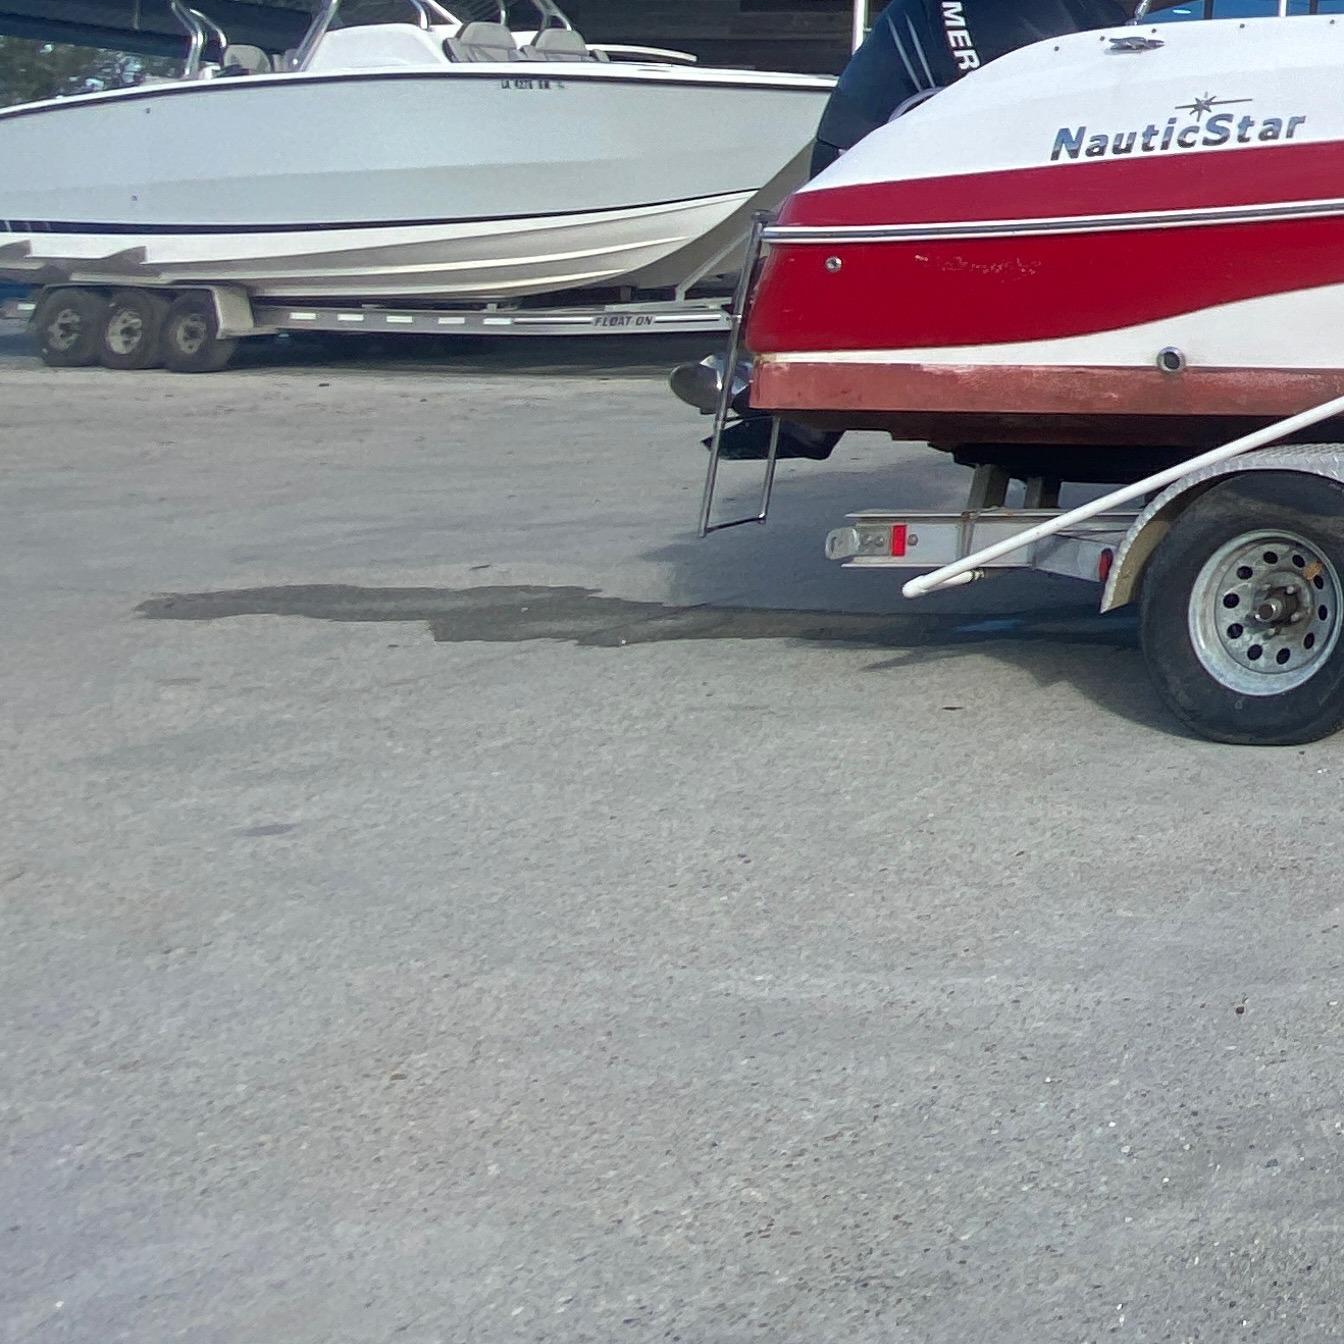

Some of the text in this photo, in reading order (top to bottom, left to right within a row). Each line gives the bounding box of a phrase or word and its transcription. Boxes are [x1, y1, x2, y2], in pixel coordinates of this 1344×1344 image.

[1050, 113, 1306, 160] NauticStar
[594, 315, 654, 327] FLOAT ON
